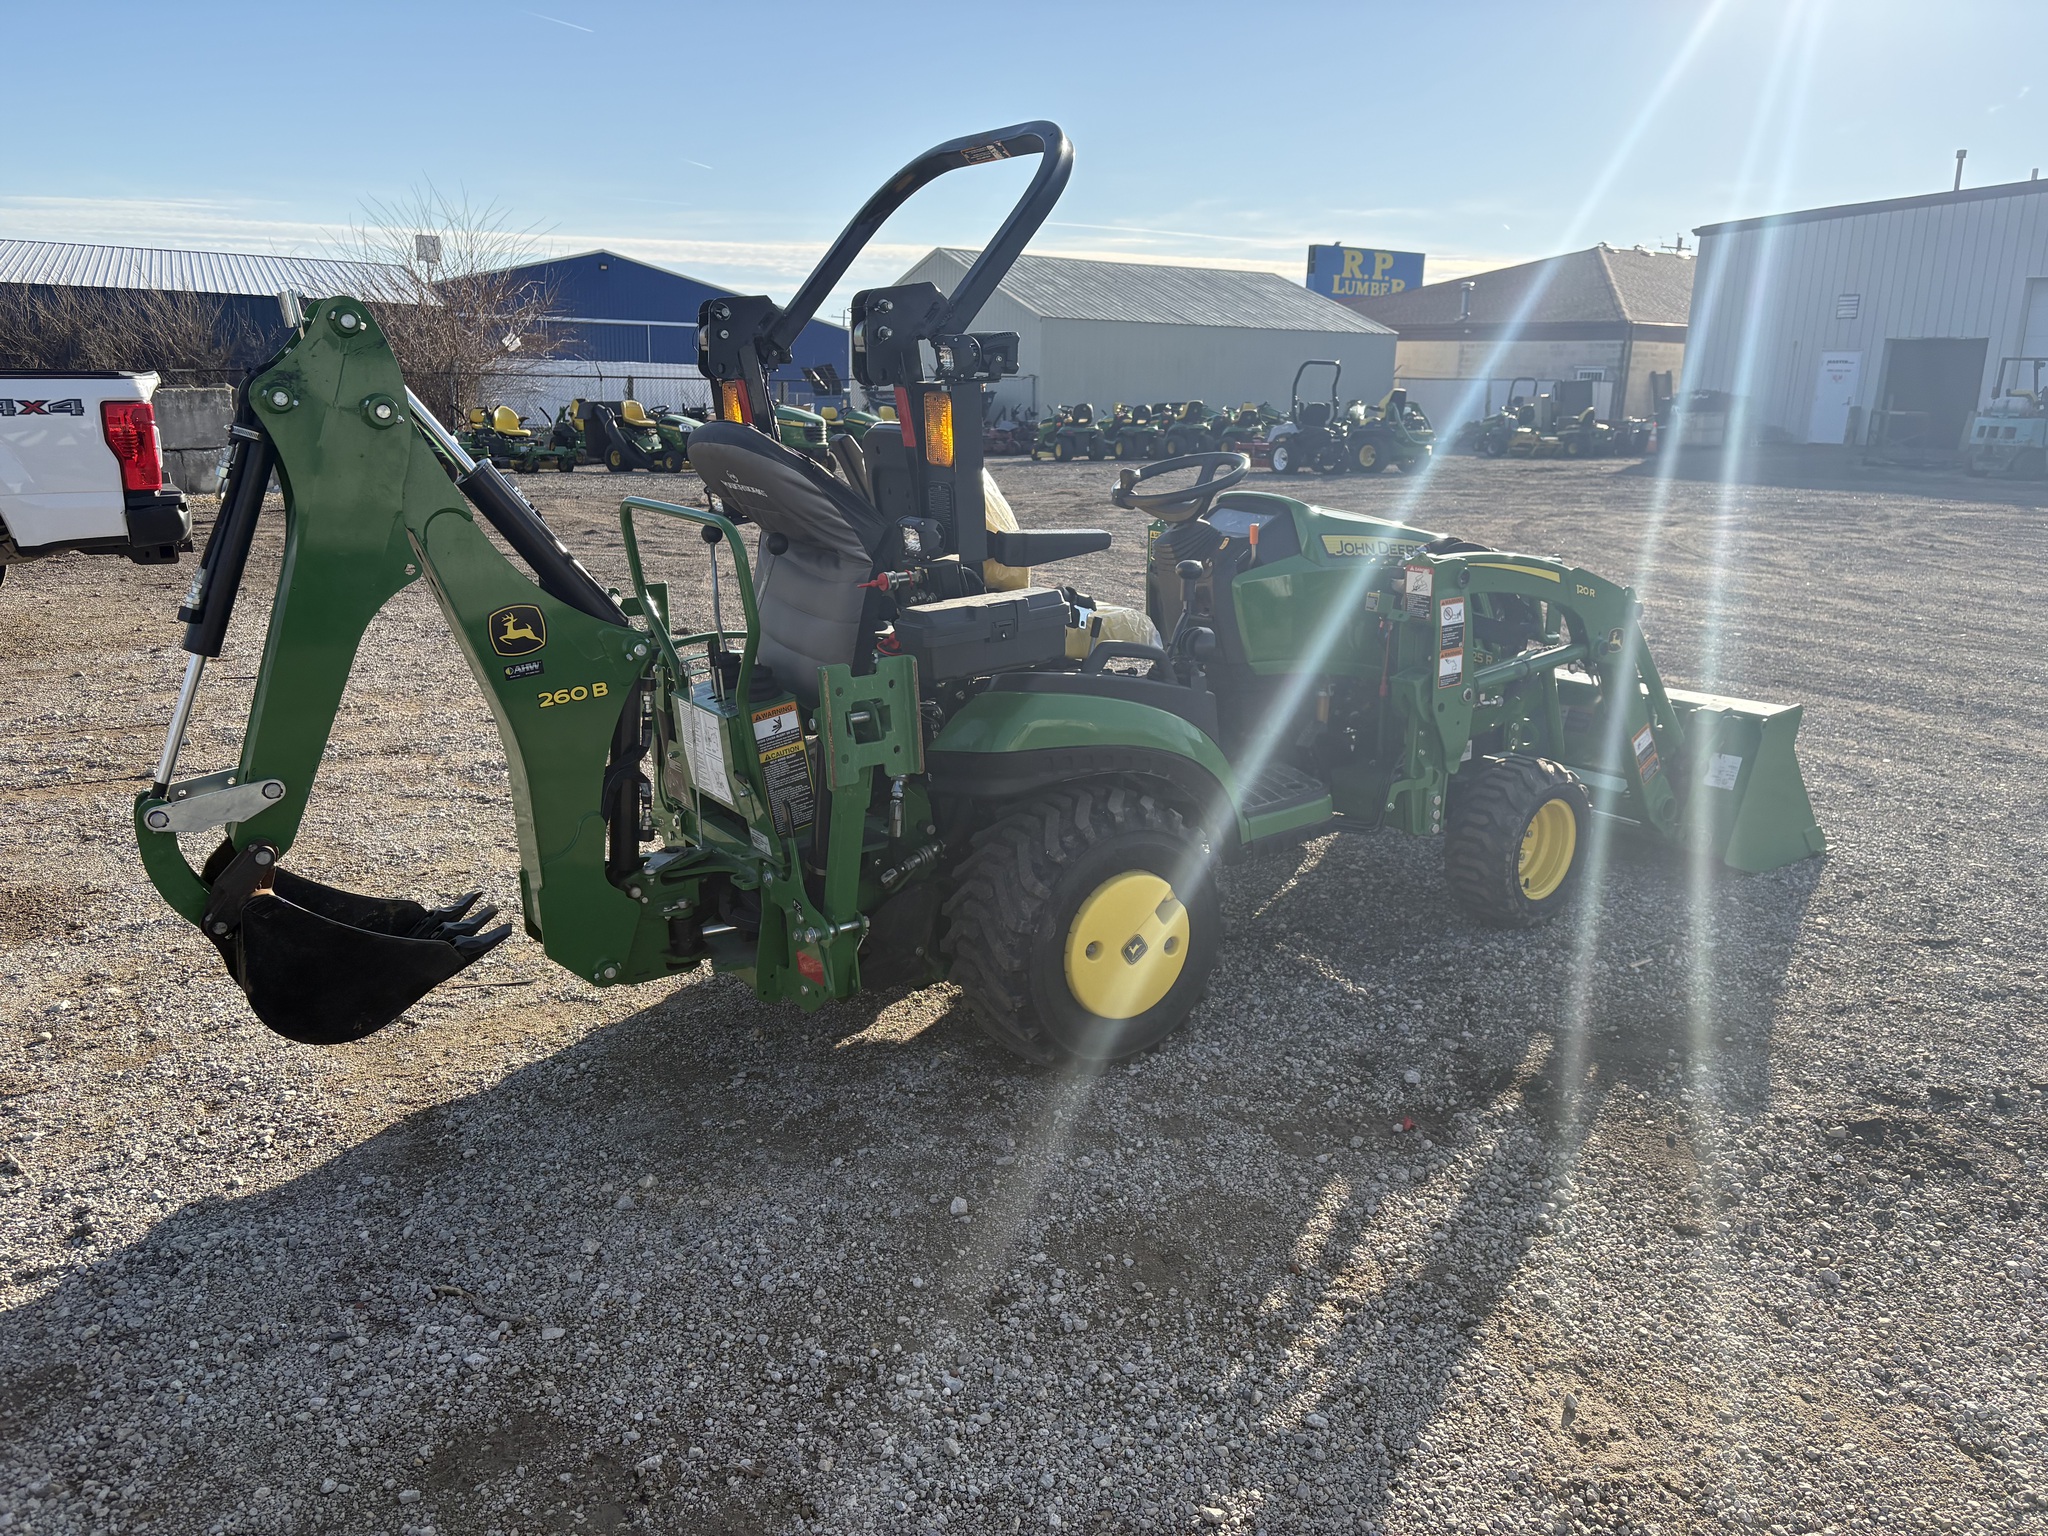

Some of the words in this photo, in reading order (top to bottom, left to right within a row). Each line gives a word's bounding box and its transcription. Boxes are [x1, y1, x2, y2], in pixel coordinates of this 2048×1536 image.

[1332, 274, 1405, 297] LUMBER
[1336, 540, 1376, 556] JOHN
[1576, 584, 1589, 596] 120
[1589, 588, 1596, 598] R
[514, 662, 540, 674] AHW
[538, 685, 588, 708] 260
[591, 682, 609, 699] B
[761, 704, 793, 719] WARNING
[770, 745, 800, 759] CAUTION
